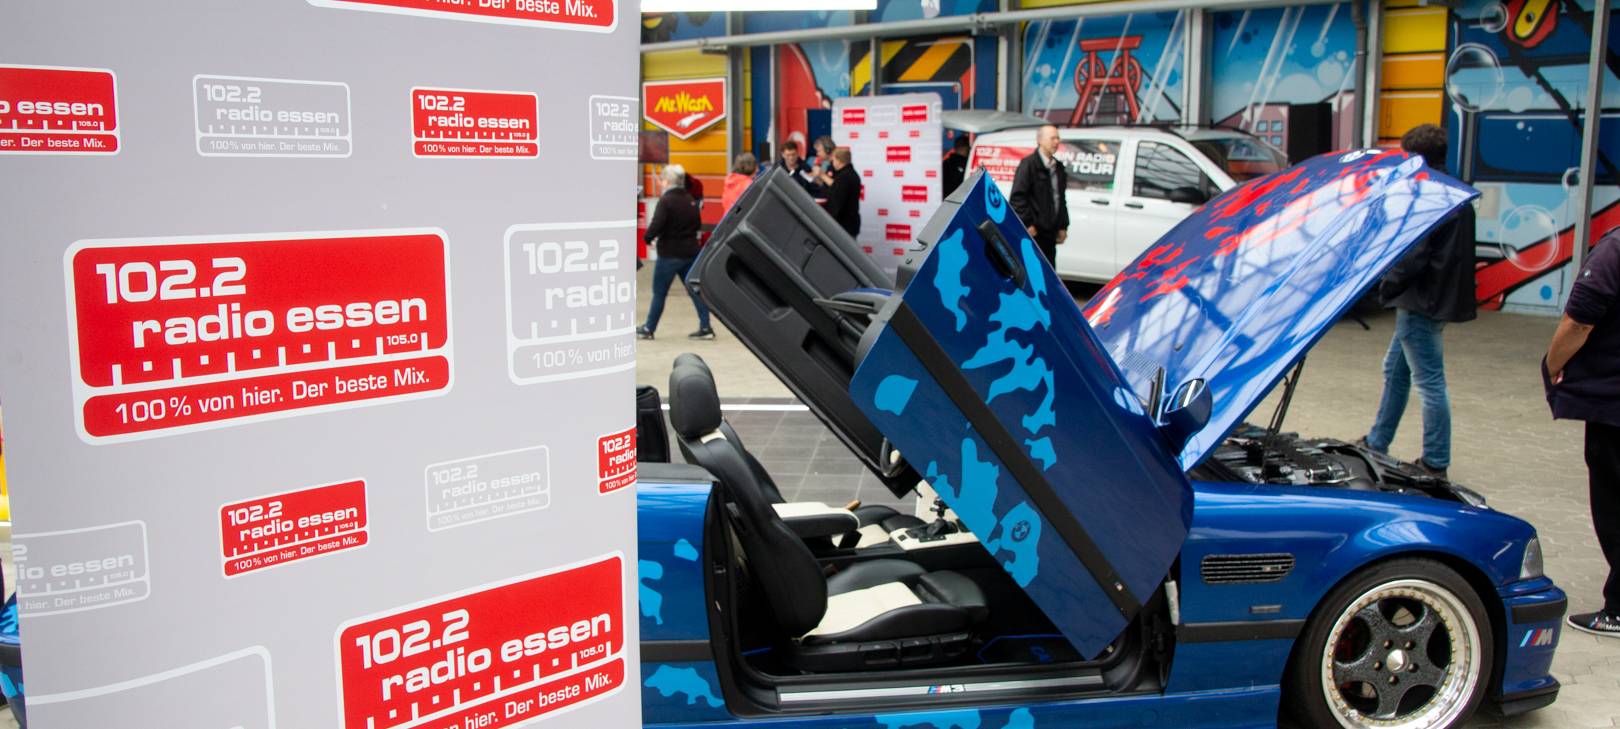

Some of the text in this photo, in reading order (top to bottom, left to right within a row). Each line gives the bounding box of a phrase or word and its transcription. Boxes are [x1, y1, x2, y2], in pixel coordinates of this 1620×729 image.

[565, 3, 598, 18] Mix.
[203, 83, 262, 104] 102.2
[418, 94, 466, 112] 102.2
[17, 101, 104, 116] essen
[215, 105, 340, 124] radio essen
[596, 102, 630, 118] 102.2
[428, 113, 530, 129] radio essen
[604, 119, 634, 132] radio
[21, 137, 44, 147] Der
[47, 138, 80, 148] beste
[83, 138, 107, 148] Mix.
[241, 143, 257, 151] von
[462, 145, 477, 153] hier.
[480, 145, 493, 153] Der
[494, 146, 514, 154] beste
[1072, 161, 1114, 175] TOUR
[523, 239, 620, 275] 102.2
[96, 256, 247, 304] 102.2
[545, 275, 632, 310] radio
[132, 297, 427, 348] radio essen
[386, 333, 418, 346] 105.0
[587, 349, 611, 363] von
[198, 393, 235, 414] von
[242, 387, 284, 409] hier.
[292, 380, 329, 401] Der
[335, 373, 388, 395] beste
[394, 367, 430, 387] Mix.
[603, 434, 631, 454] 102.2
[609, 448, 634, 467] radio
[433, 464, 478, 486] 102.2
[442, 480, 488, 500] radio
[491, 471, 541, 489] essen
[228, 500, 283, 527] 102.2
[240, 507, 358, 541] radio essen
[264, 554, 278, 564] von
[280, 550, 298, 560] hier.
[301, 546, 316, 556] Der
[318, 541, 341, 552] beste
[342, 536, 359, 547] Mix.
[51, 554, 134, 577] essen
[356, 609, 470, 669] 102.2
[382, 613, 612, 701] radio essen
[580, 643, 605, 659] 105.0
[465, 671, 613, 729] hier. Der beste Mix.
